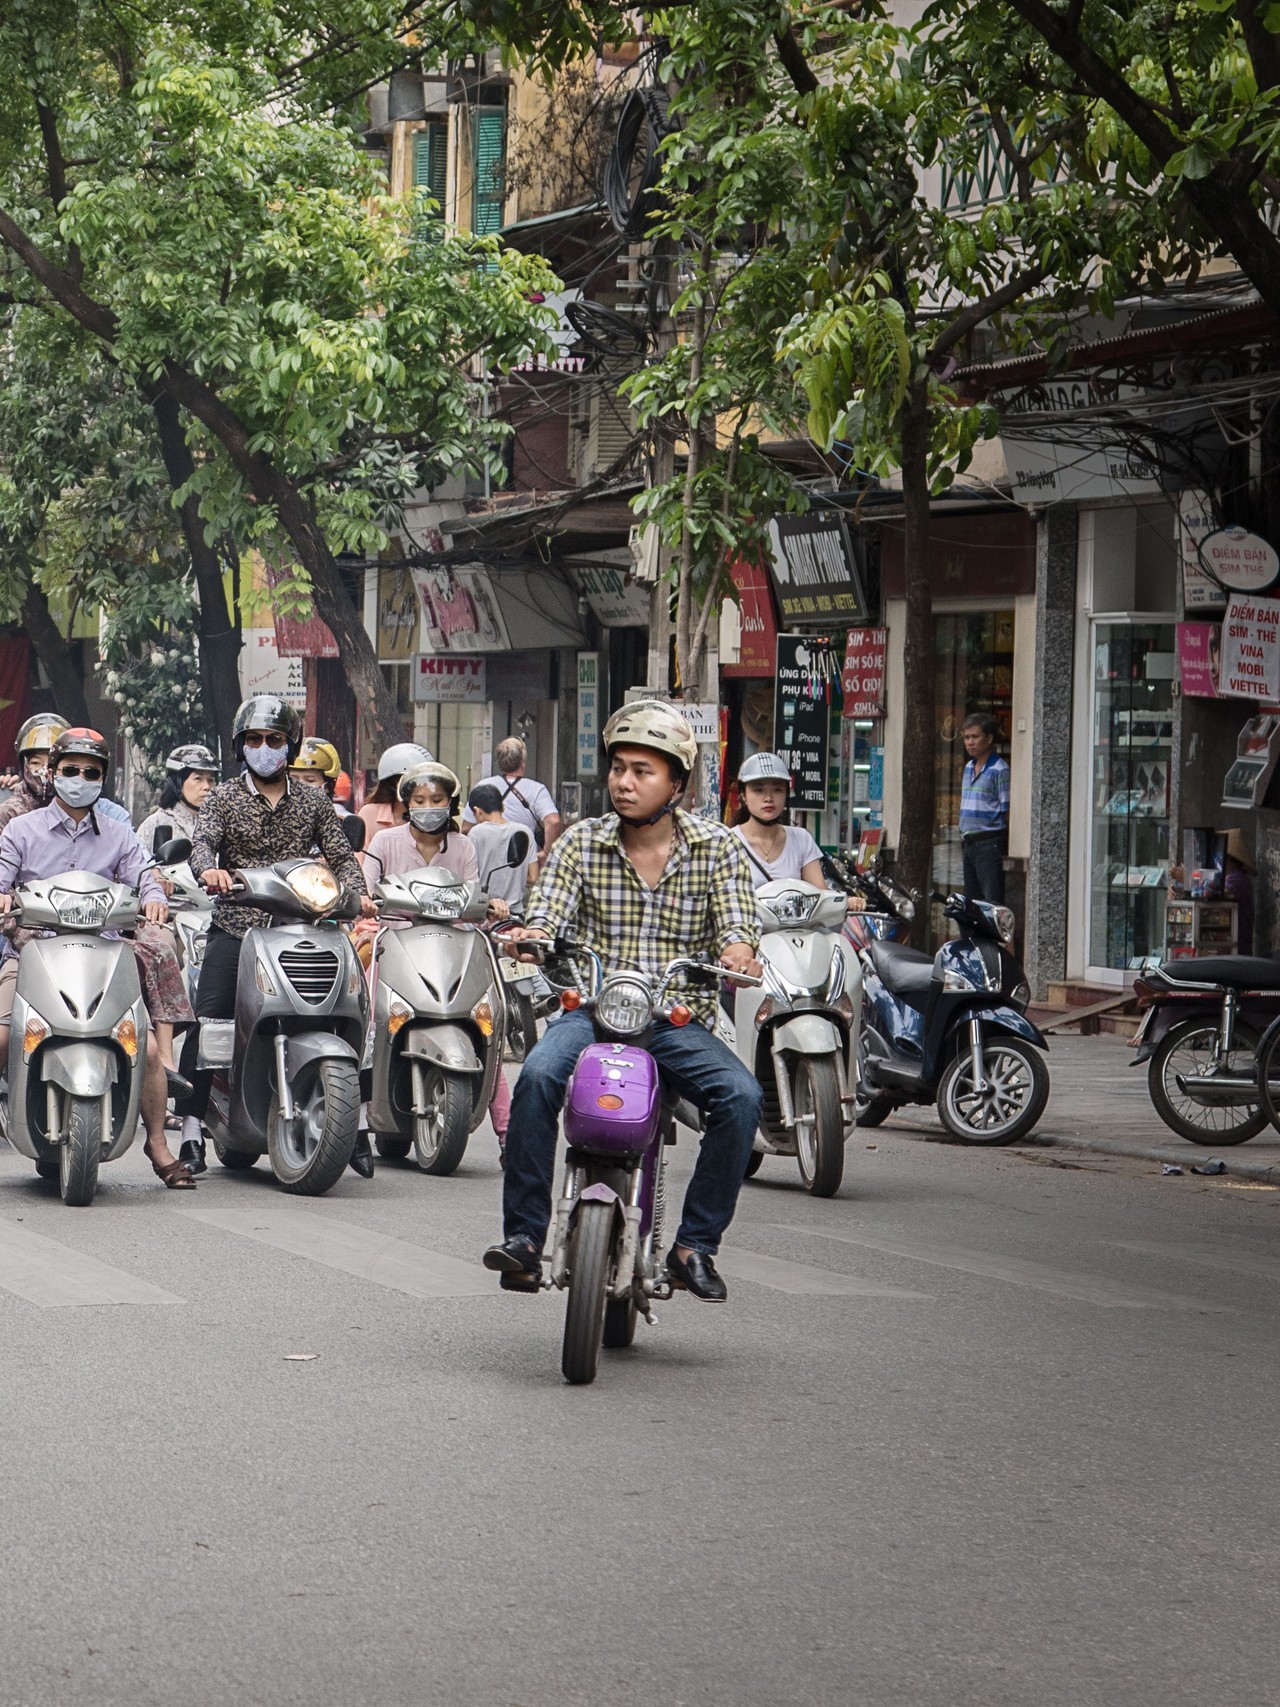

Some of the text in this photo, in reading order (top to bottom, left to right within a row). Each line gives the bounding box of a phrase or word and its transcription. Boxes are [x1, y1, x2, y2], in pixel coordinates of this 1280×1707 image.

[784, 530, 851, 586] SMART PHONE
[1219, 563, 1240, 574] SIM
[833, 593, 857, 610] VIETTEL
[1229, 625, 1248, 638] SIM
[848, 631, 864, 646] SIM
[1240, 643, 1264, 659] VINA
[420, 658, 483, 675] KITTY
[845, 656, 860, 669] SIM
[1237, 661, 1264, 677] MOBI
[780, 667, 799, 678] ỨNG
[782, 685, 800, 697] PHỤ
[1230, 678, 1270, 696] VIETTEL
[799, 702, 814, 711] iPad
[680, 709, 704, 719] BÁN
[798, 733, 821, 743] iPhone
[791, 750, 801, 770] 3G
[806, 752, 819, 762] VINA
[805, 771, 821, 781] MOBIL
[805, 790, 825, 800] VIETTEL
